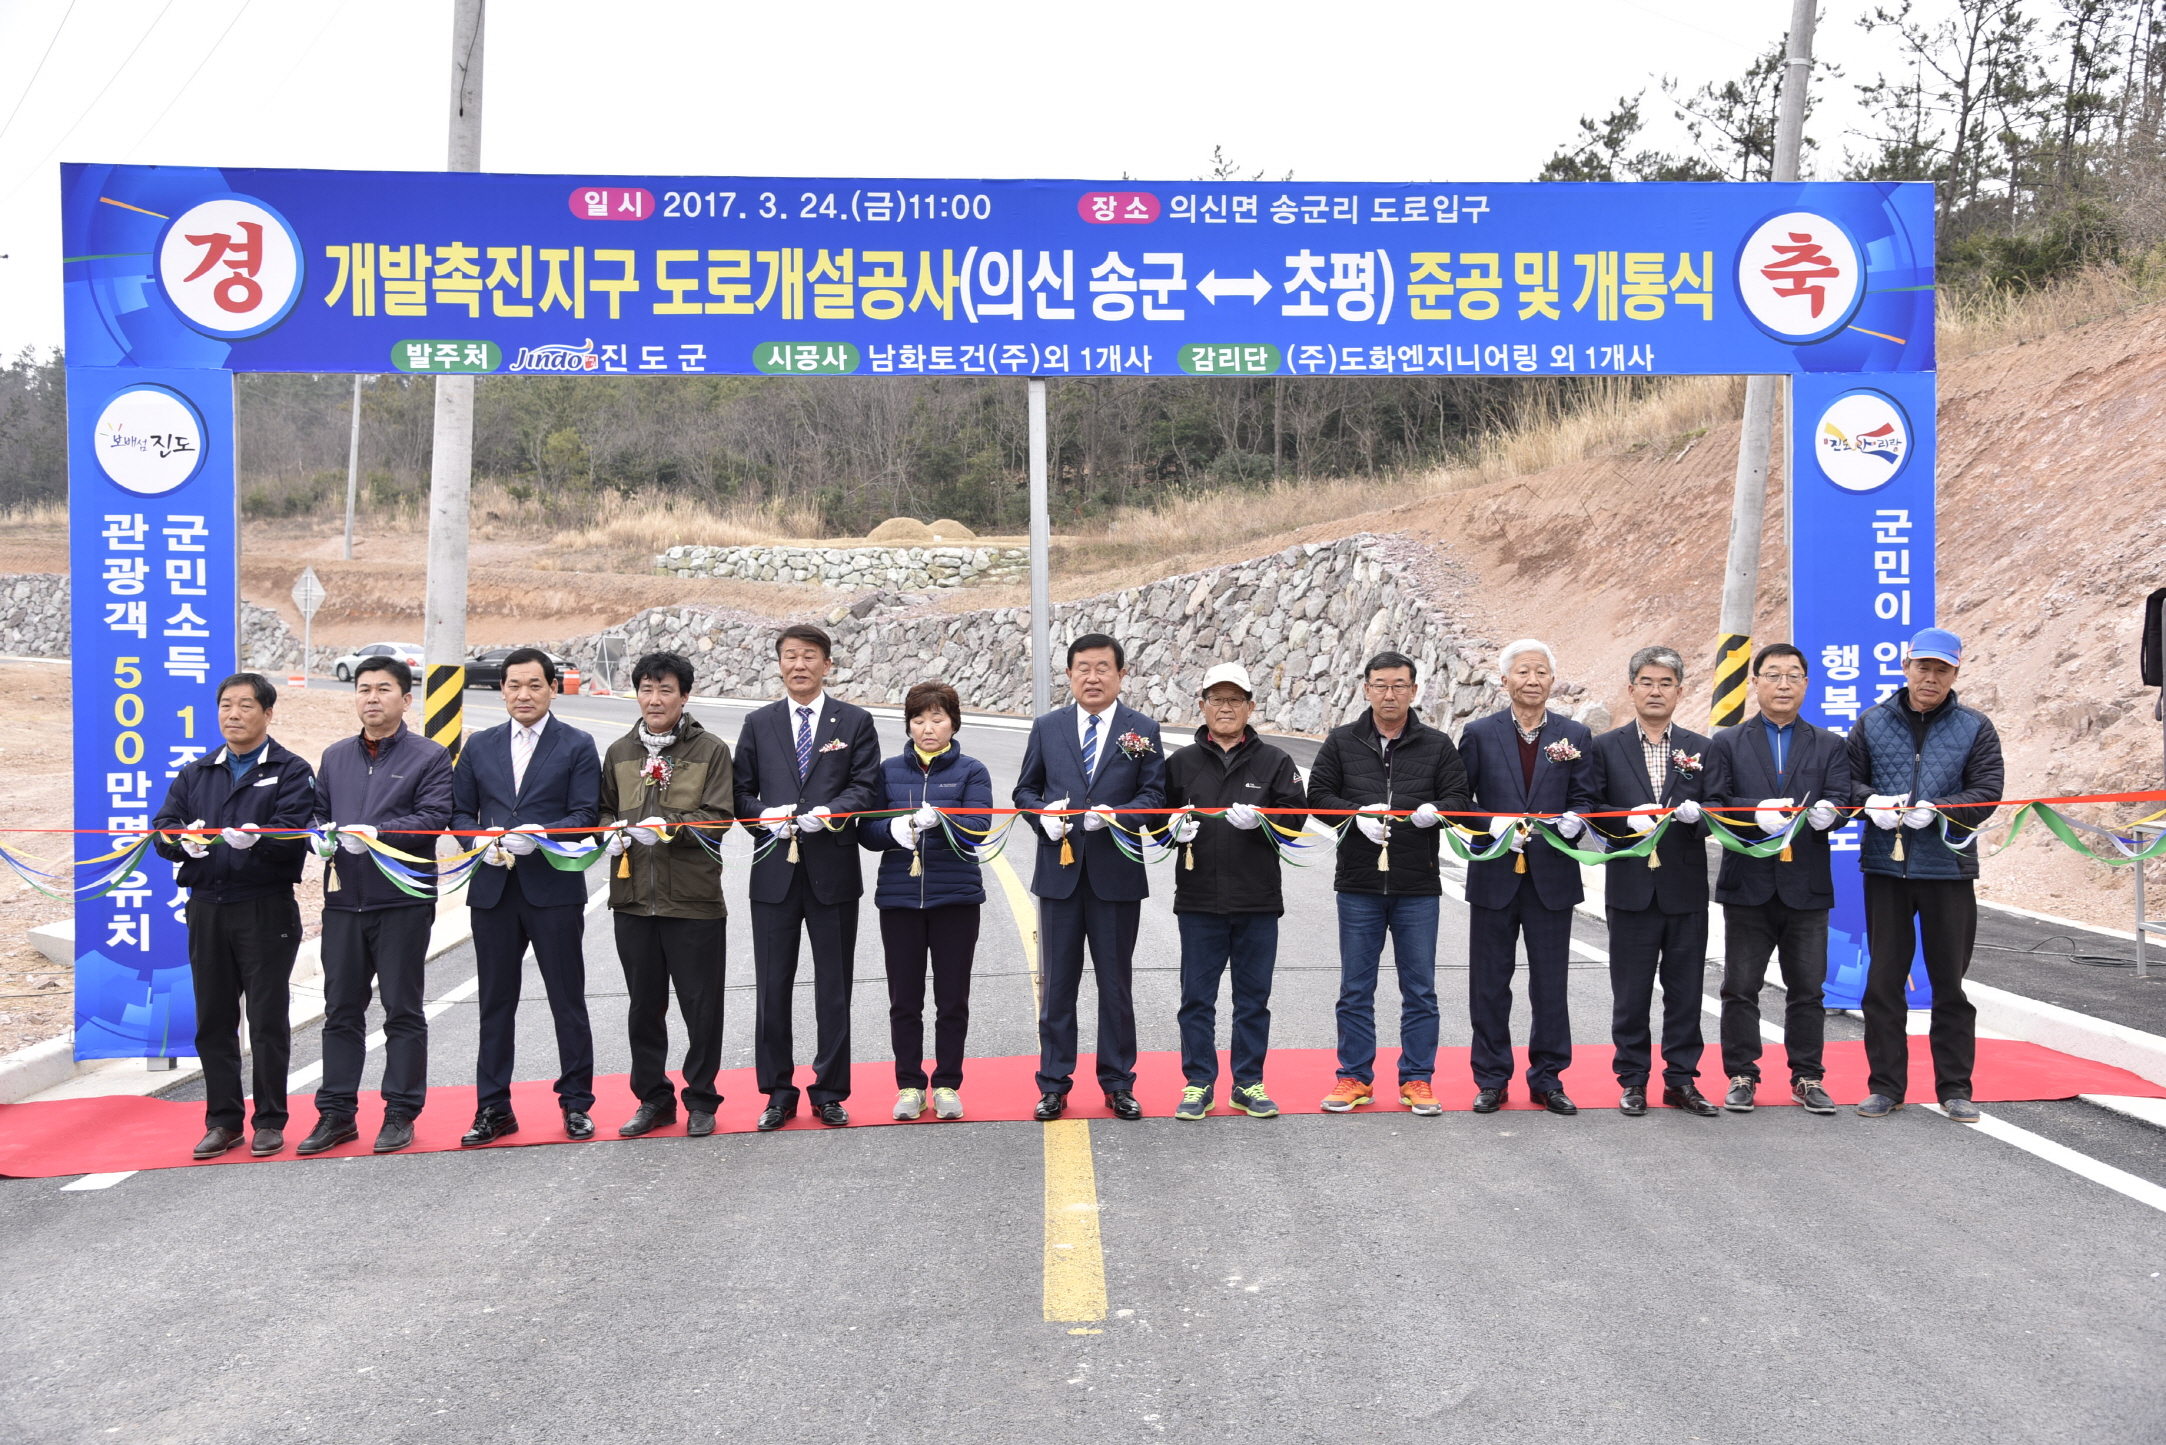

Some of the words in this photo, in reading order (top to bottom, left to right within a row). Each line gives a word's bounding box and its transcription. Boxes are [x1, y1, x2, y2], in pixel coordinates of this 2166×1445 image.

[663, 190, 746, 219] 2017.
[759, 191, 788, 220] 3.
[1169, 194, 1258, 224] 의신면
[1270, 194, 1358, 225] 송군리
[1370, 194, 1490, 224] 도로입구
[184, 221, 263, 313] 경
[324, 242, 640, 320] 개발촉진지구
[1089, 251, 1188, 322] 송군
[1281, 248, 1395, 325] 초평)
[1407, 251, 1504, 321] 준공
[1514, 250, 1562, 321] 및
[1572, 250, 1714, 321] 개통식
[1761, 232, 1840, 318] 축
[406, 343, 489, 370] 발주처
[509, 347, 583, 371] Jindo
[767, 344, 848, 371] 시공사
[869, 343, 1070, 375] 남화토건(주)외
[1080, 344, 1153, 374] 1개사
[1191, 346, 1269, 372] 감리단
[1287, 343, 1538, 375] (주)도화엔지니어링
[1549, 344, 1576, 373] 외
[1585, 343, 1655, 373] 1개사
[110, 434, 148, 452] 보배섬
[150, 433, 196, 458] 진도
[101, 513, 150, 639] 관광객
[162, 514, 210, 684] 군민소득
[1872, 509, 1913, 626] 군민이
[105, 870, 153, 952] 유치
